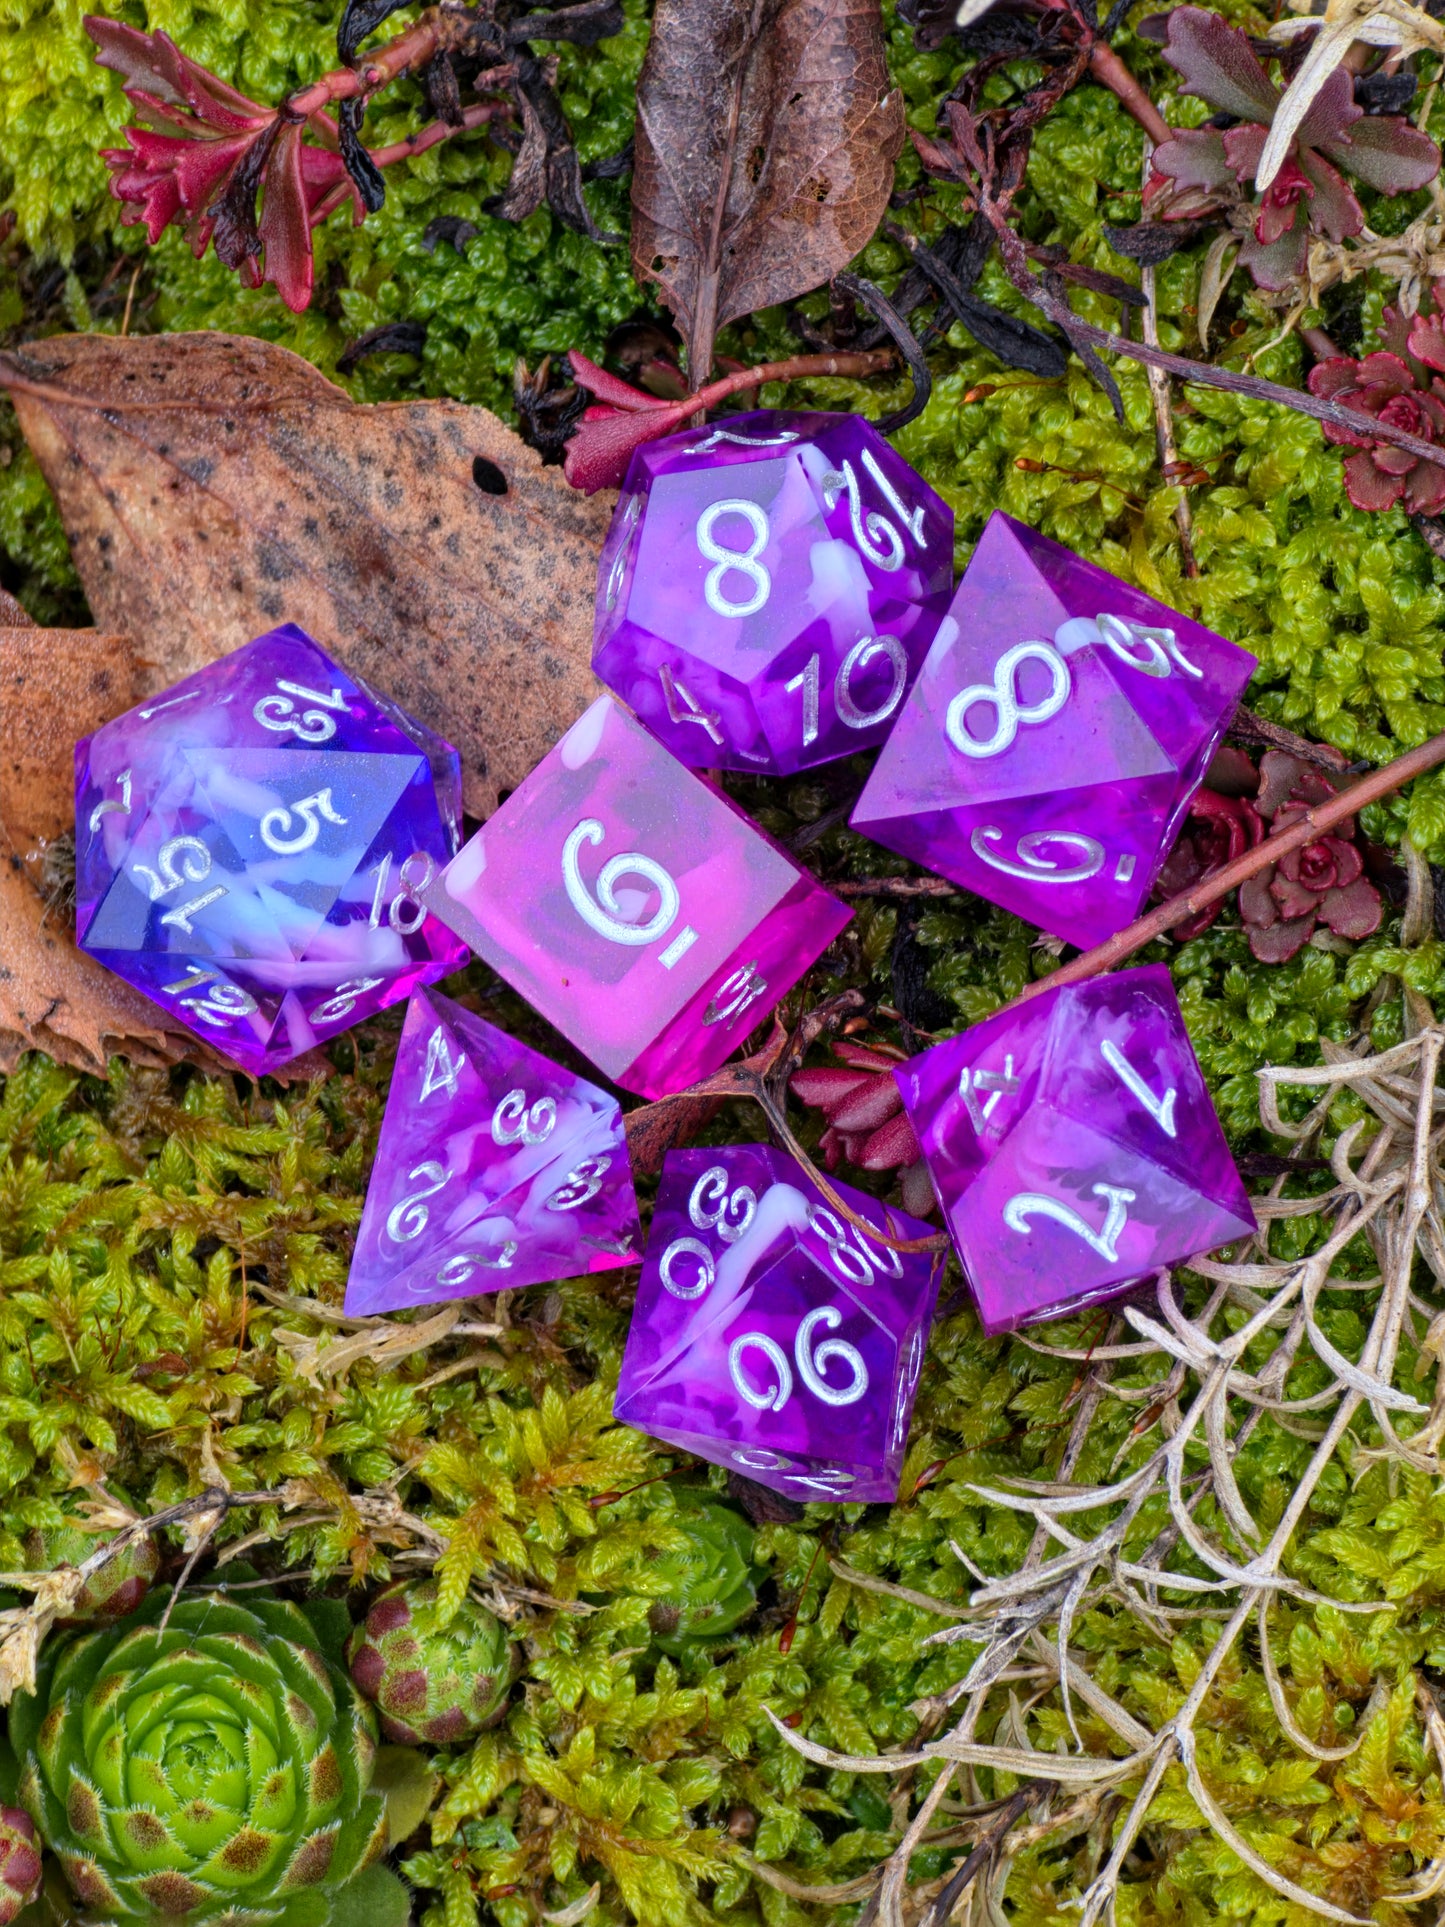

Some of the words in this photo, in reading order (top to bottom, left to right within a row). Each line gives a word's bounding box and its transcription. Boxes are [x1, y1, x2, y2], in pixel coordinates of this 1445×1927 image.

[696, 499, 771, 618] 8
[1096, 613, 1203, 678] 5
[253, 678, 351, 743] 13
[658, 662, 724, 745] 4
[785, 634, 907, 747] 10
[946, 640, 1071, 758] 8
[260, 788, 348, 854] 5
[133, 836, 231, 935] 15
[368, 851, 436, 935] 18
[562, 817, 680, 946] 6
[419, 1025, 465, 1102] 4
[958, 1053, 1020, 1136] 4
[1101, 1040, 1177, 1138] 1
[491, 1089, 556, 1146] 3
[387, 1160, 454, 1243] 2
[546, 1156, 612, 1211] 3
[437, 1240, 518, 1285] 2
[659, 1166, 757, 1300] 30
[807, 1203, 904, 1286] 80
